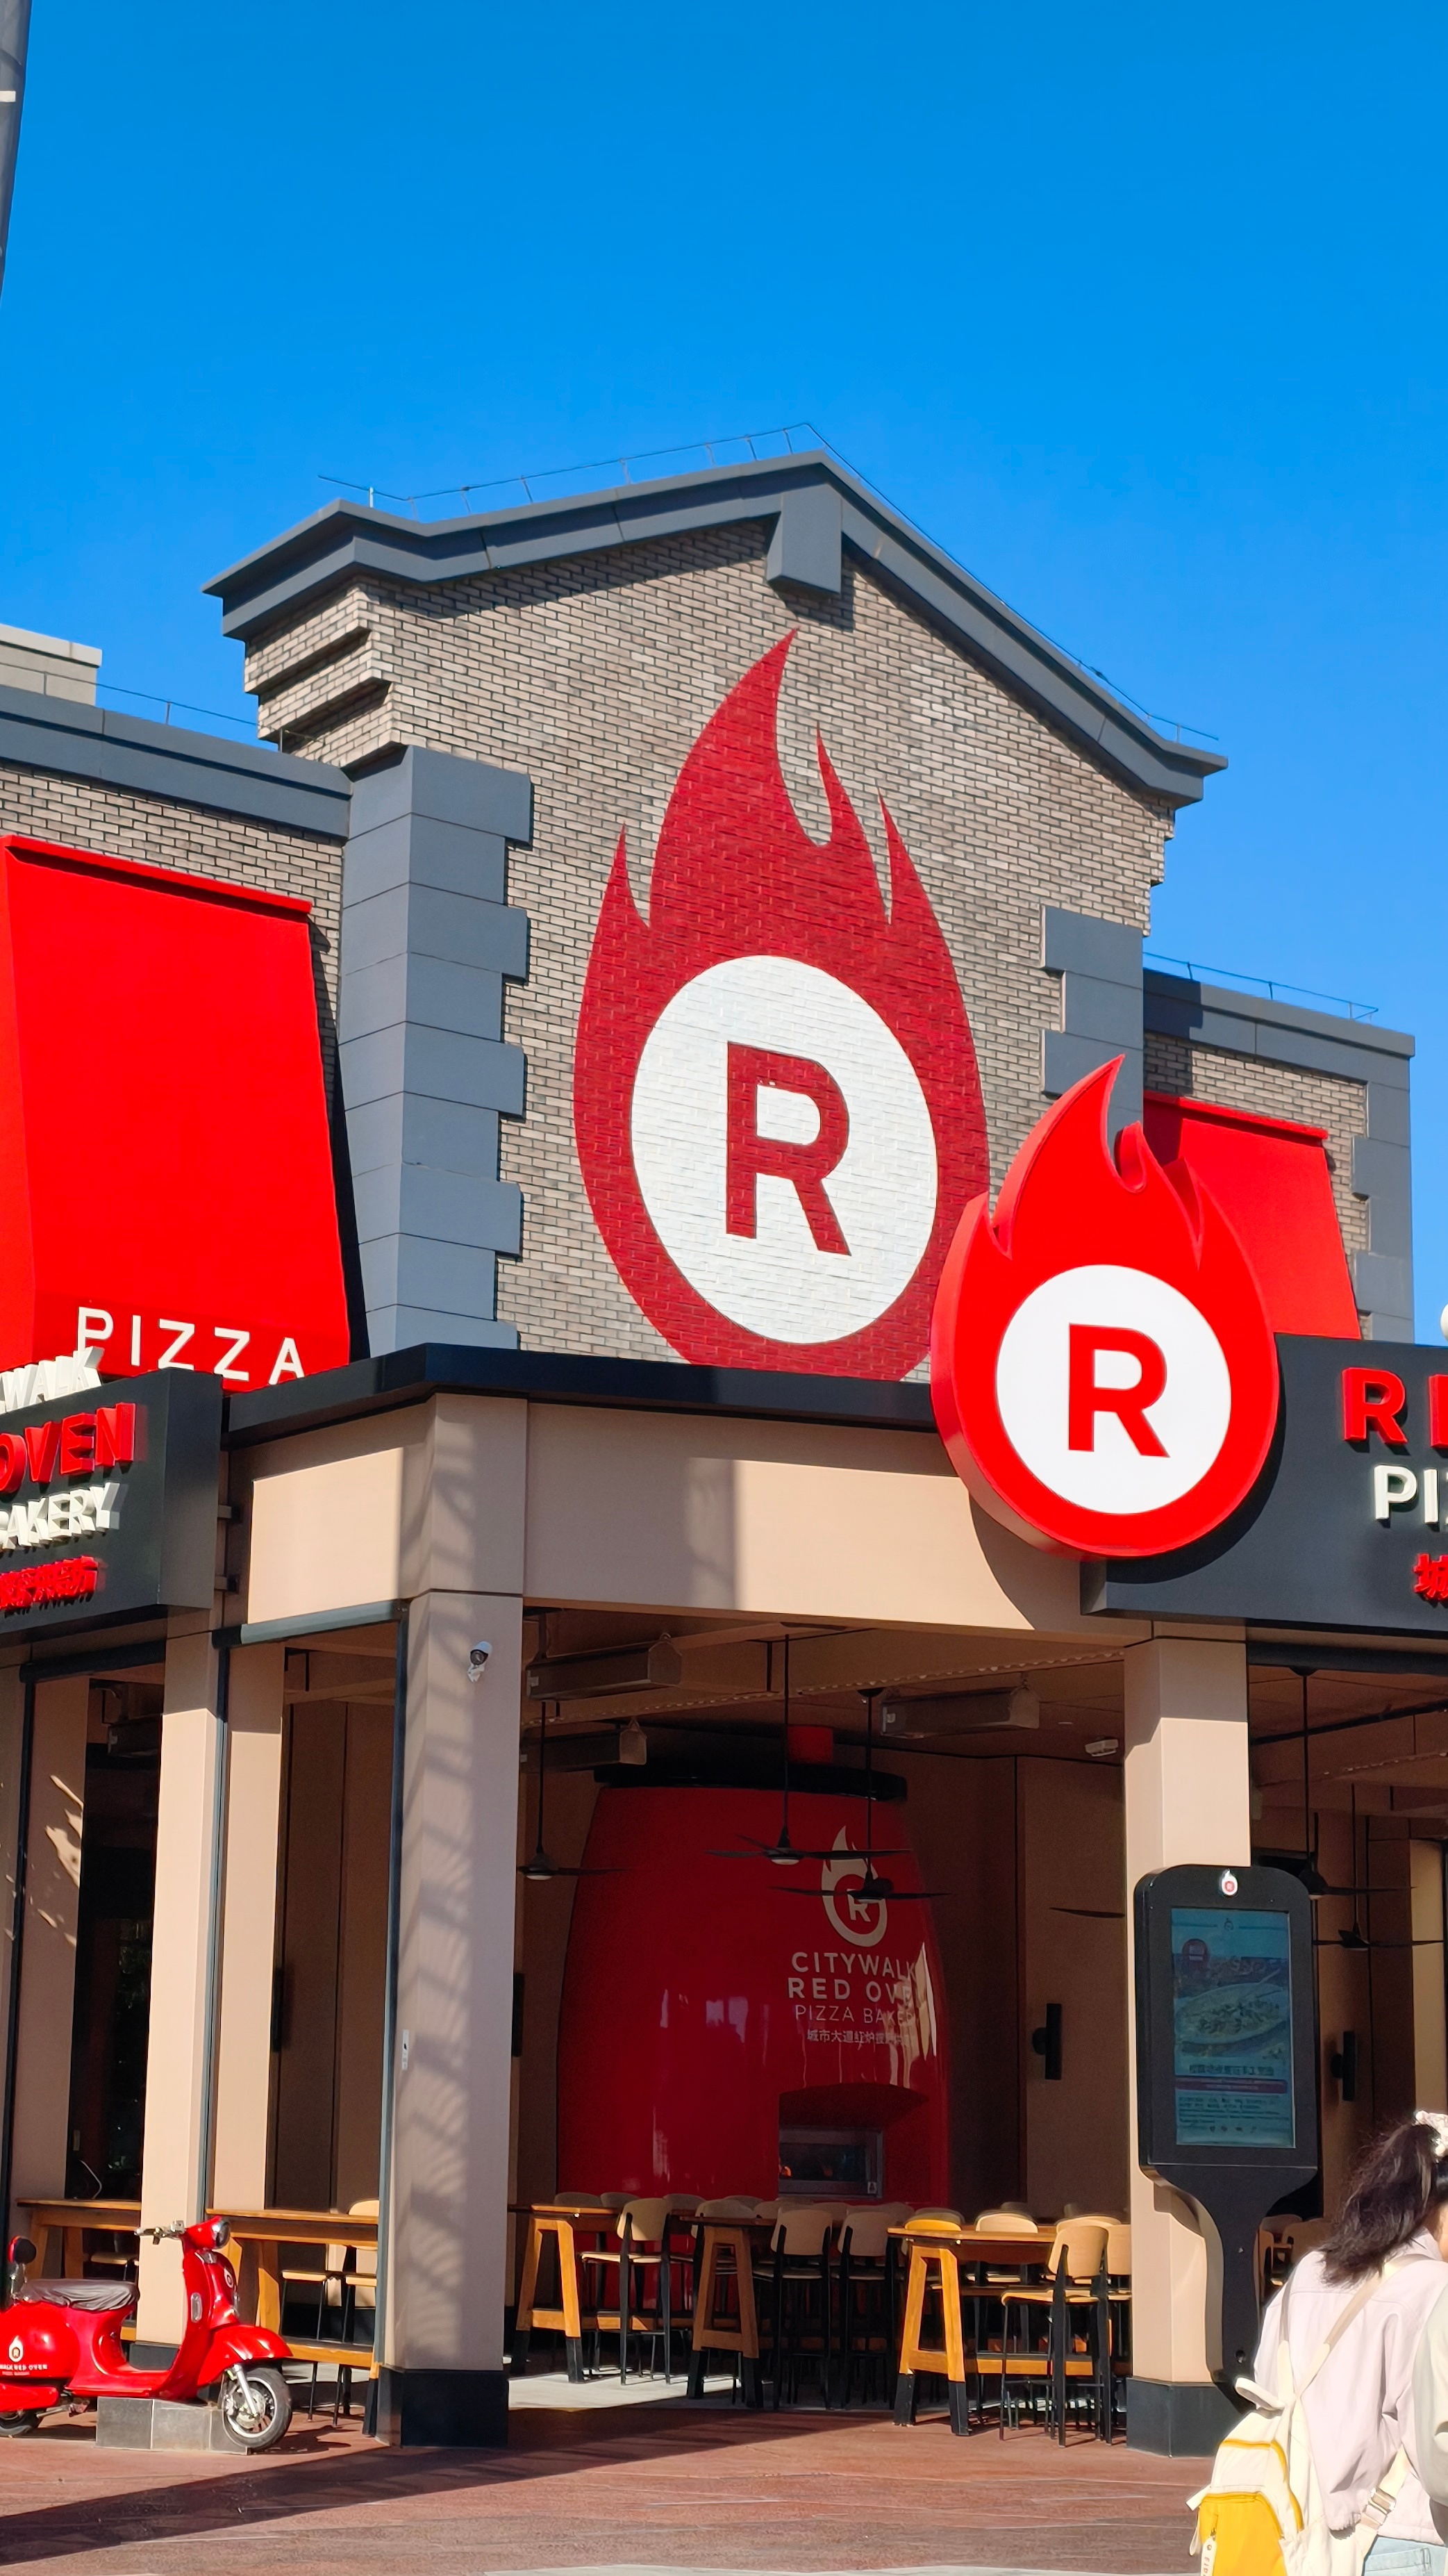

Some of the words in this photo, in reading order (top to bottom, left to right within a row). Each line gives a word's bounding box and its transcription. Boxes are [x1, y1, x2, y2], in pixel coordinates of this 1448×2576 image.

[726, 1041, 852, 1257] R
[0, 1346, 105, 1414] WALK
[78, 1306, 305, 1386] PIZZA
[1067, 1323, 1171, 1458] R
[0, 1482, 119, 1551] AKERY
[1374, 1464, 1448, 1524] PI
[788, 1977, 851, 2000] RED
[791, 1951, 915, 1981] CITYWALK
[795, 2004, 854, 2022] PIZZA
